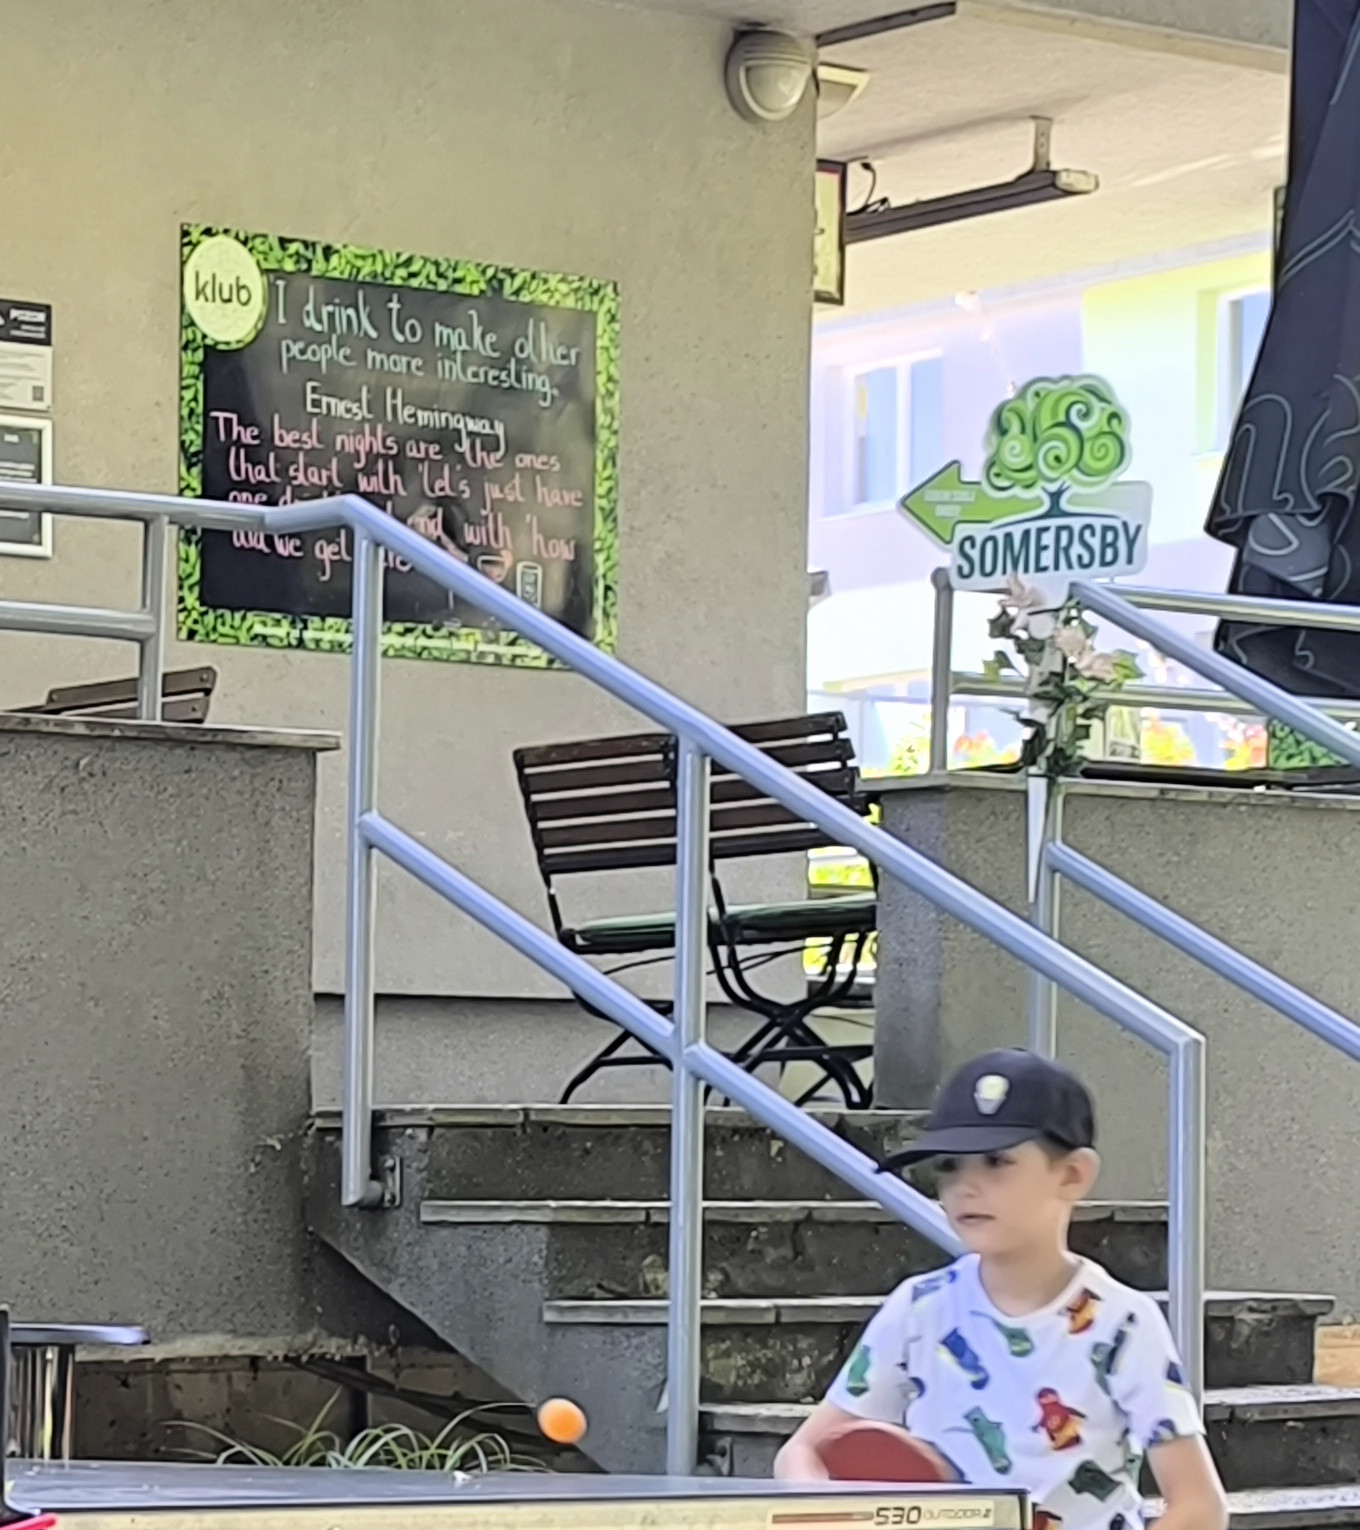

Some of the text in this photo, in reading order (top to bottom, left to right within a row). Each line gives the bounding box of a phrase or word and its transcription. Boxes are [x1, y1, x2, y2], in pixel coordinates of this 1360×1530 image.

[194, 271, 252, 306] klub
[273, 278, 579, 367] I drink to make other
[281, 335, 357, 375] people
[367, 350, 425, 376] more
[210, 410, 561, 473] The best nights are the ones
[306, 381, 506, 458] Ernest Hemingway
[229, 445, 280, 485] that
[288, 455, 342, 487] start
[357, 460, 408, 497] with
[481, 474, 525, 515] just
[535, 476, 584, 508] have
[314, 529, 353, 582] get
[464, 512, 513, 551] with
[956, 519, 1143, 580] SOMERSBY
[875, 1506, 922, 1526] 530
